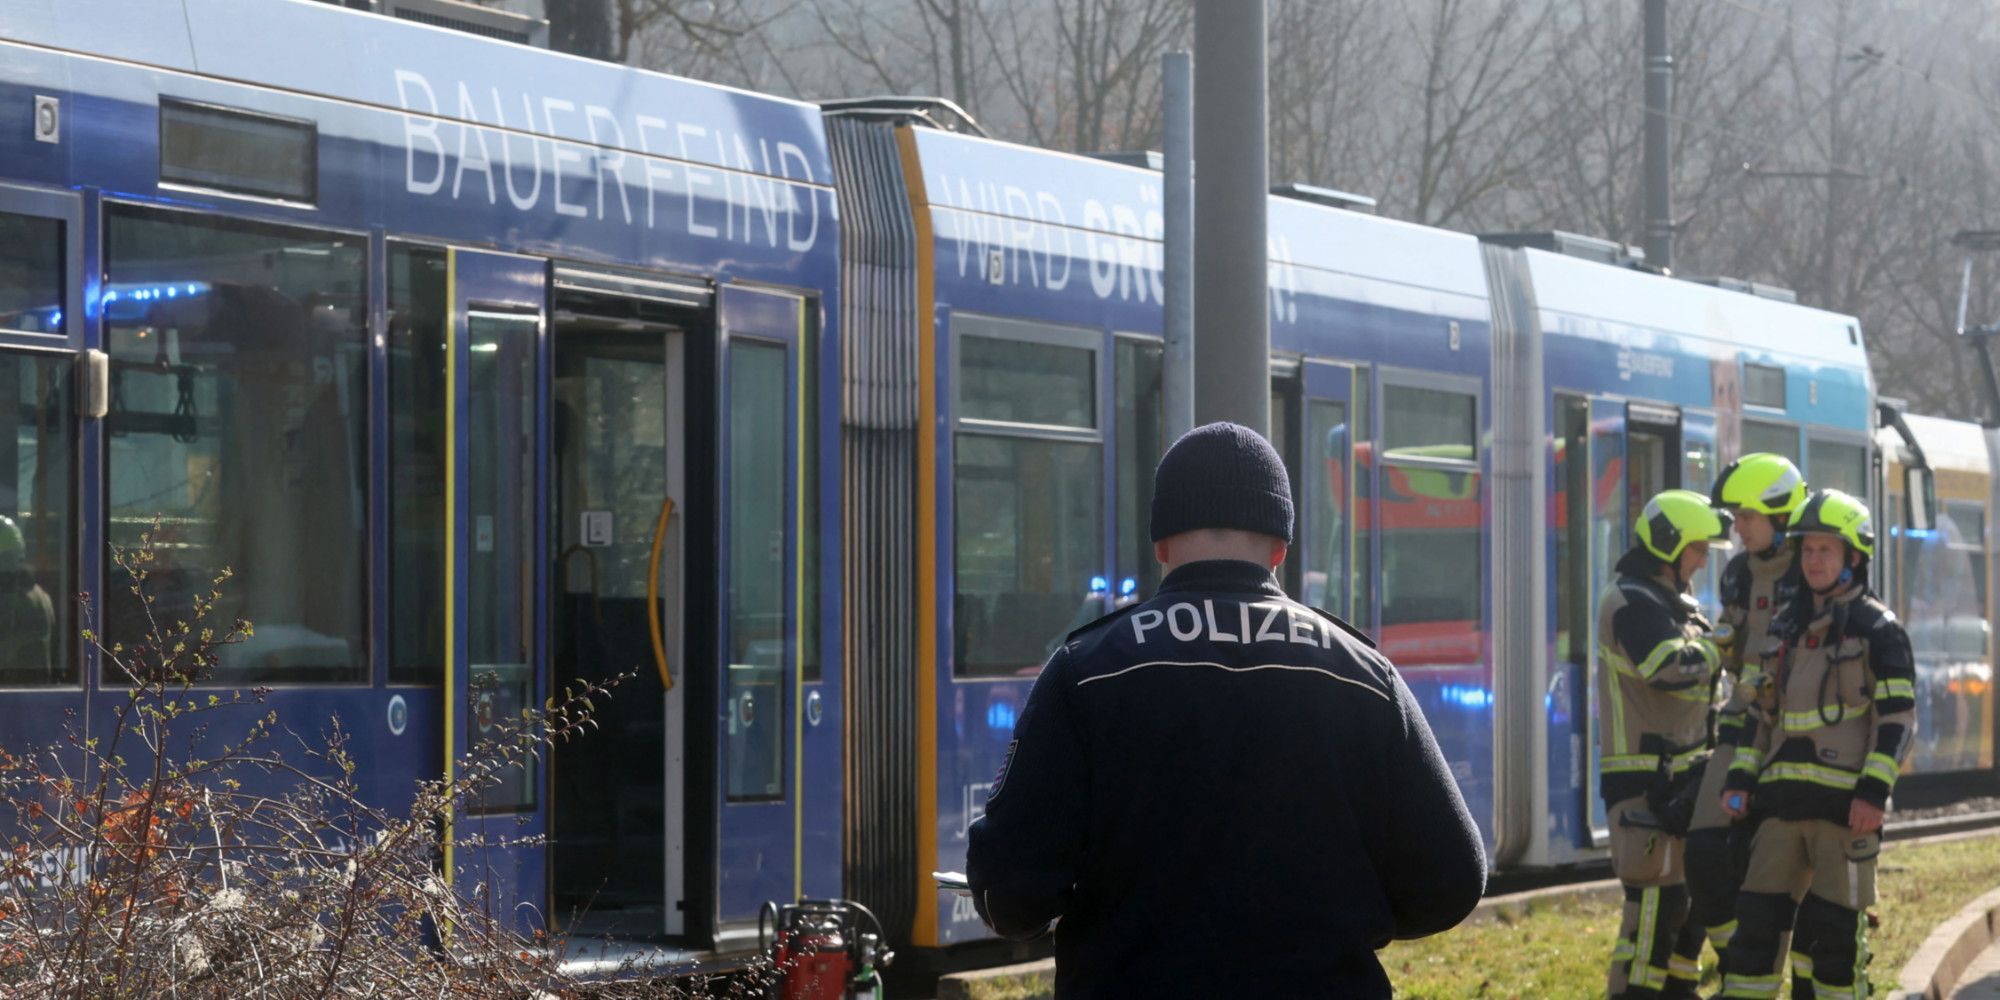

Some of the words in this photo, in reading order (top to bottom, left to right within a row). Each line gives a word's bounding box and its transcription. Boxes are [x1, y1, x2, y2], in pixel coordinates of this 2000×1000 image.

[394, 69, 819, 252] BAUERFEIND
[941, 174, 1071, 291] WIRD
[1131, 599, 1332, 649] POLIZEI
